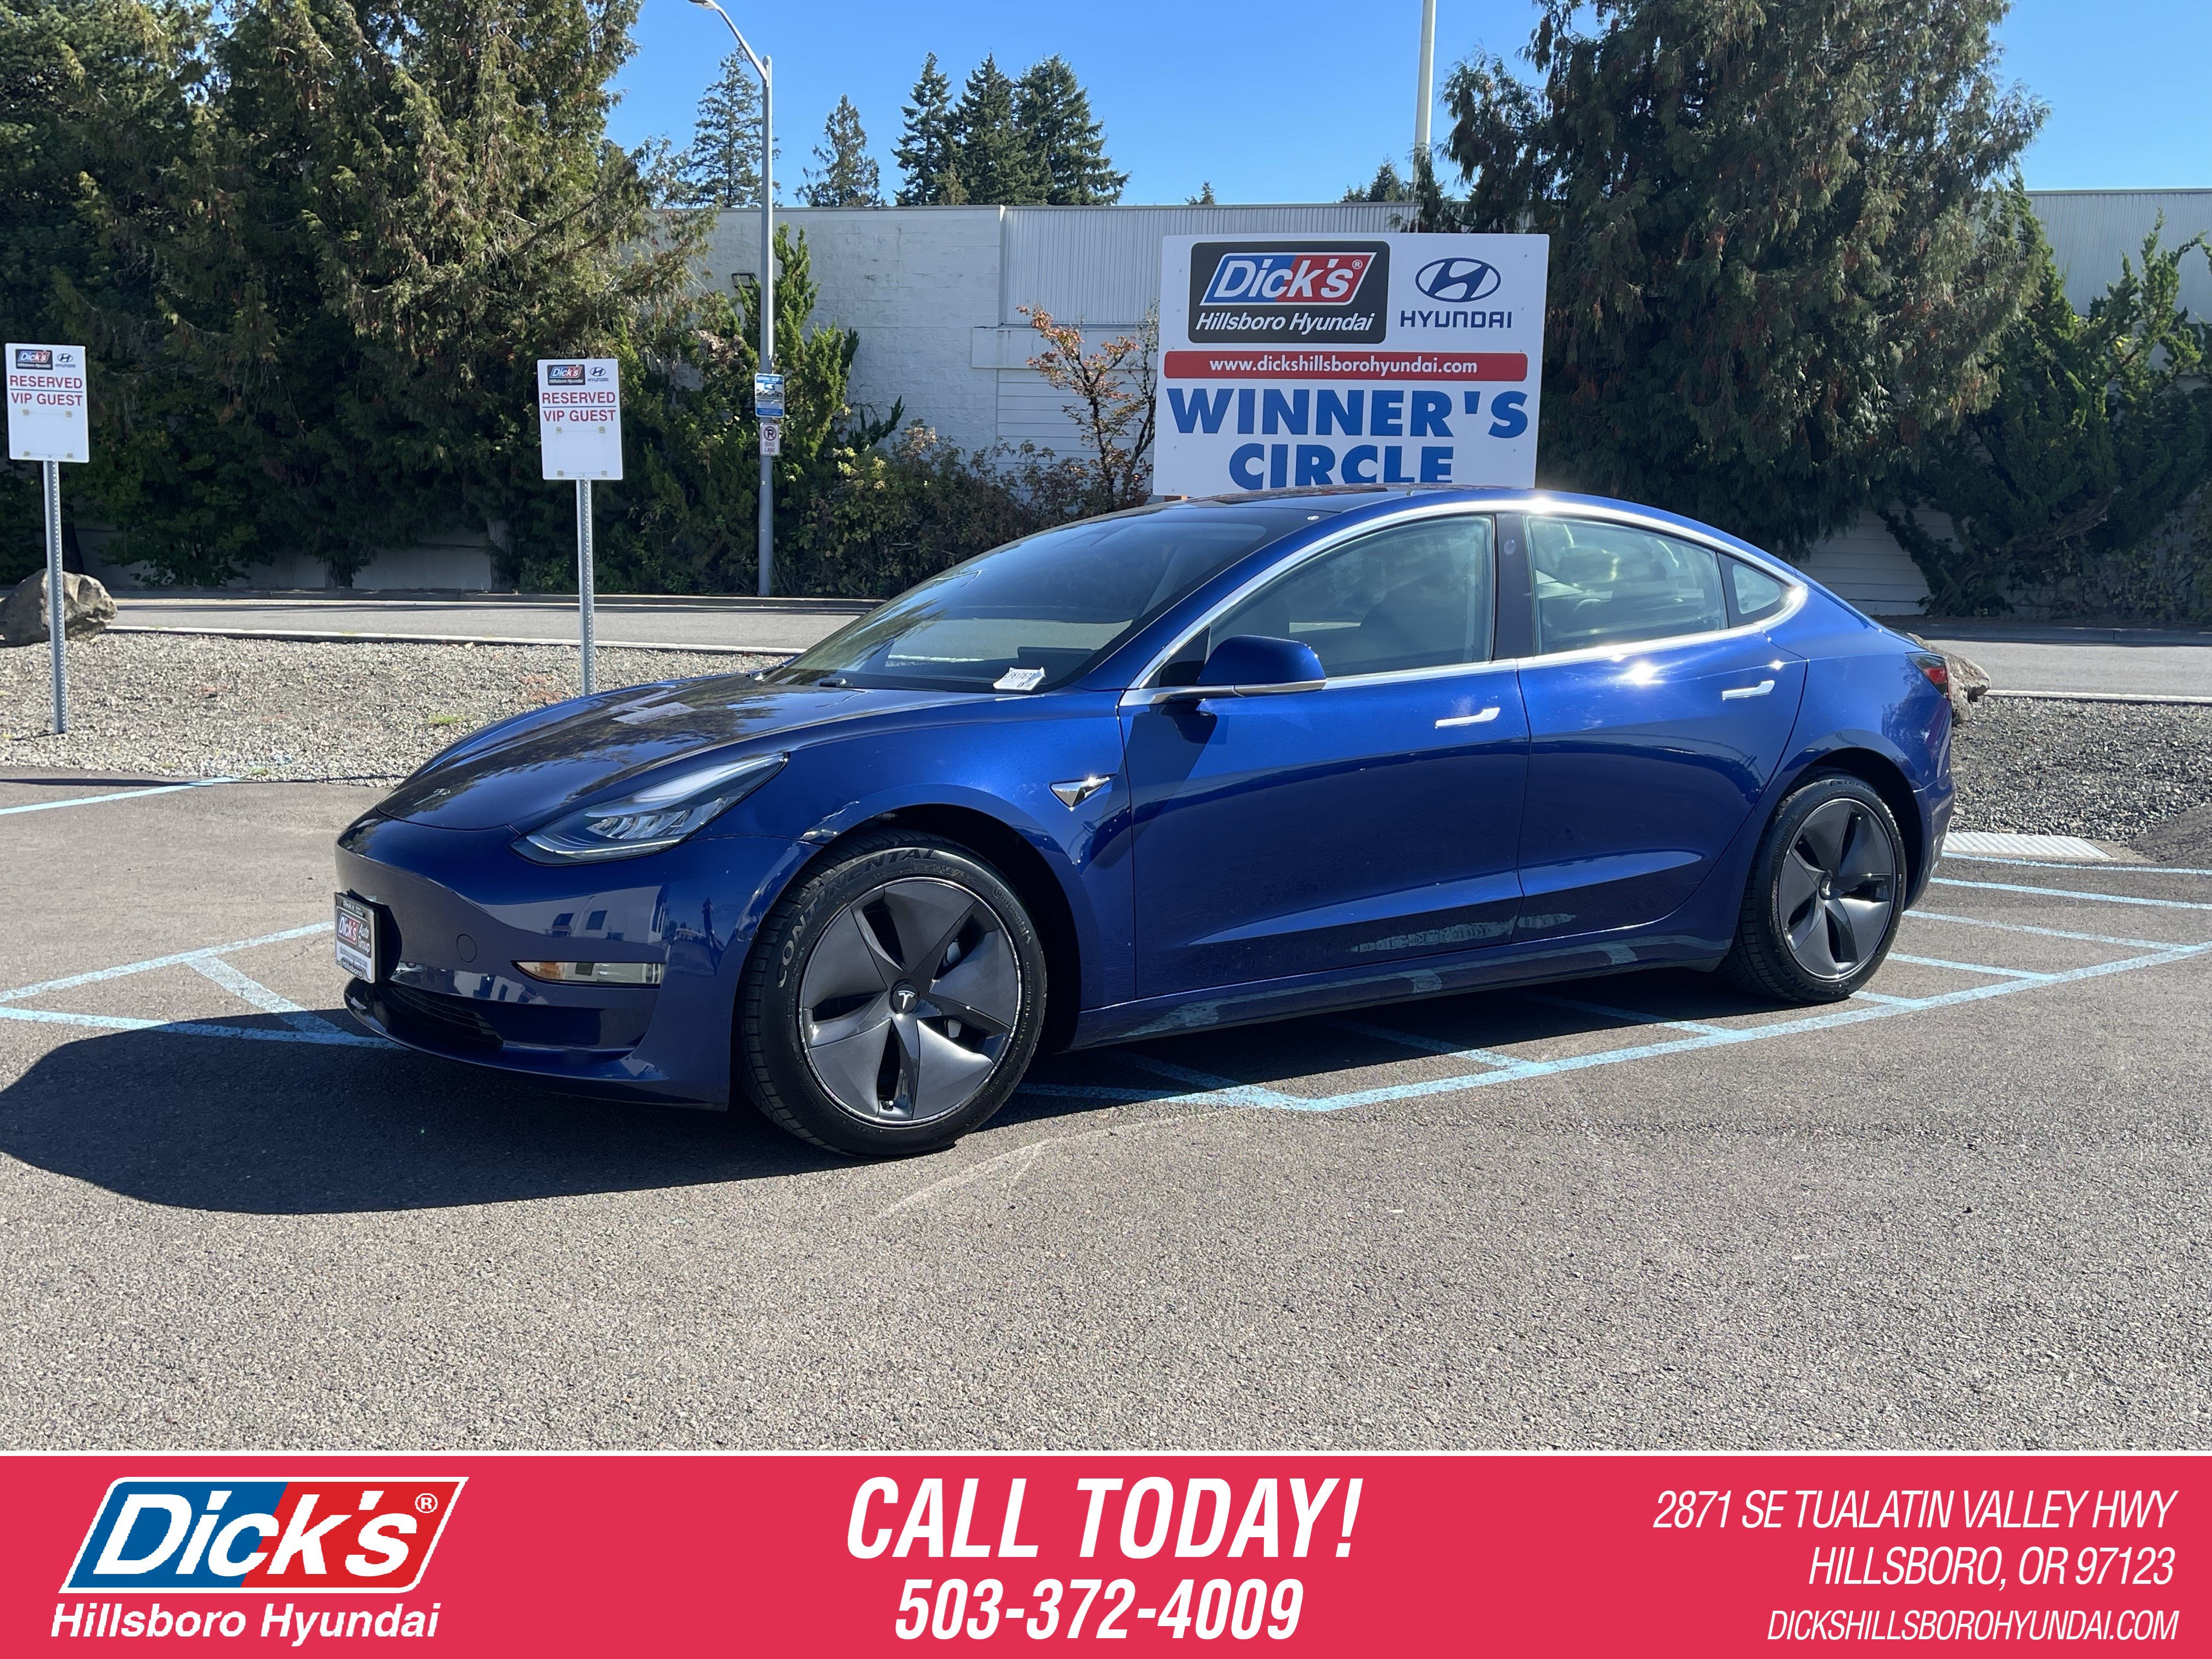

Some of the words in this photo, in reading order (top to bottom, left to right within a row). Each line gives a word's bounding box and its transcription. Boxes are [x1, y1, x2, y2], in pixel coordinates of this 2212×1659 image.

[1195, 313, 1286, 330] Hillsboro
[1289, 313, 1375, 335] Hyundai
[1401, 309, 1512, 329] HYUNDAI
[1209, 354, 1477, 377] www.dickshillsborohyundai.com
[10, 375, 83, 389] RESERVED
[11, 392, 32, 404] VIP
[37, 393, 83, 406] GUEST
[542, 392, 616, 404] RESERVED
[543, 410, 565, 422] VIP
[569, 410, 616, 422] GUEST
[1166, 388, 1528, 438] WINNER'S
[1229, 443, 1454, 490] CIRCLE
[338, 916, 357, 941] Dick's
[359, 923, 369, 939] Auto
[358, 935, 370, 953] Group
